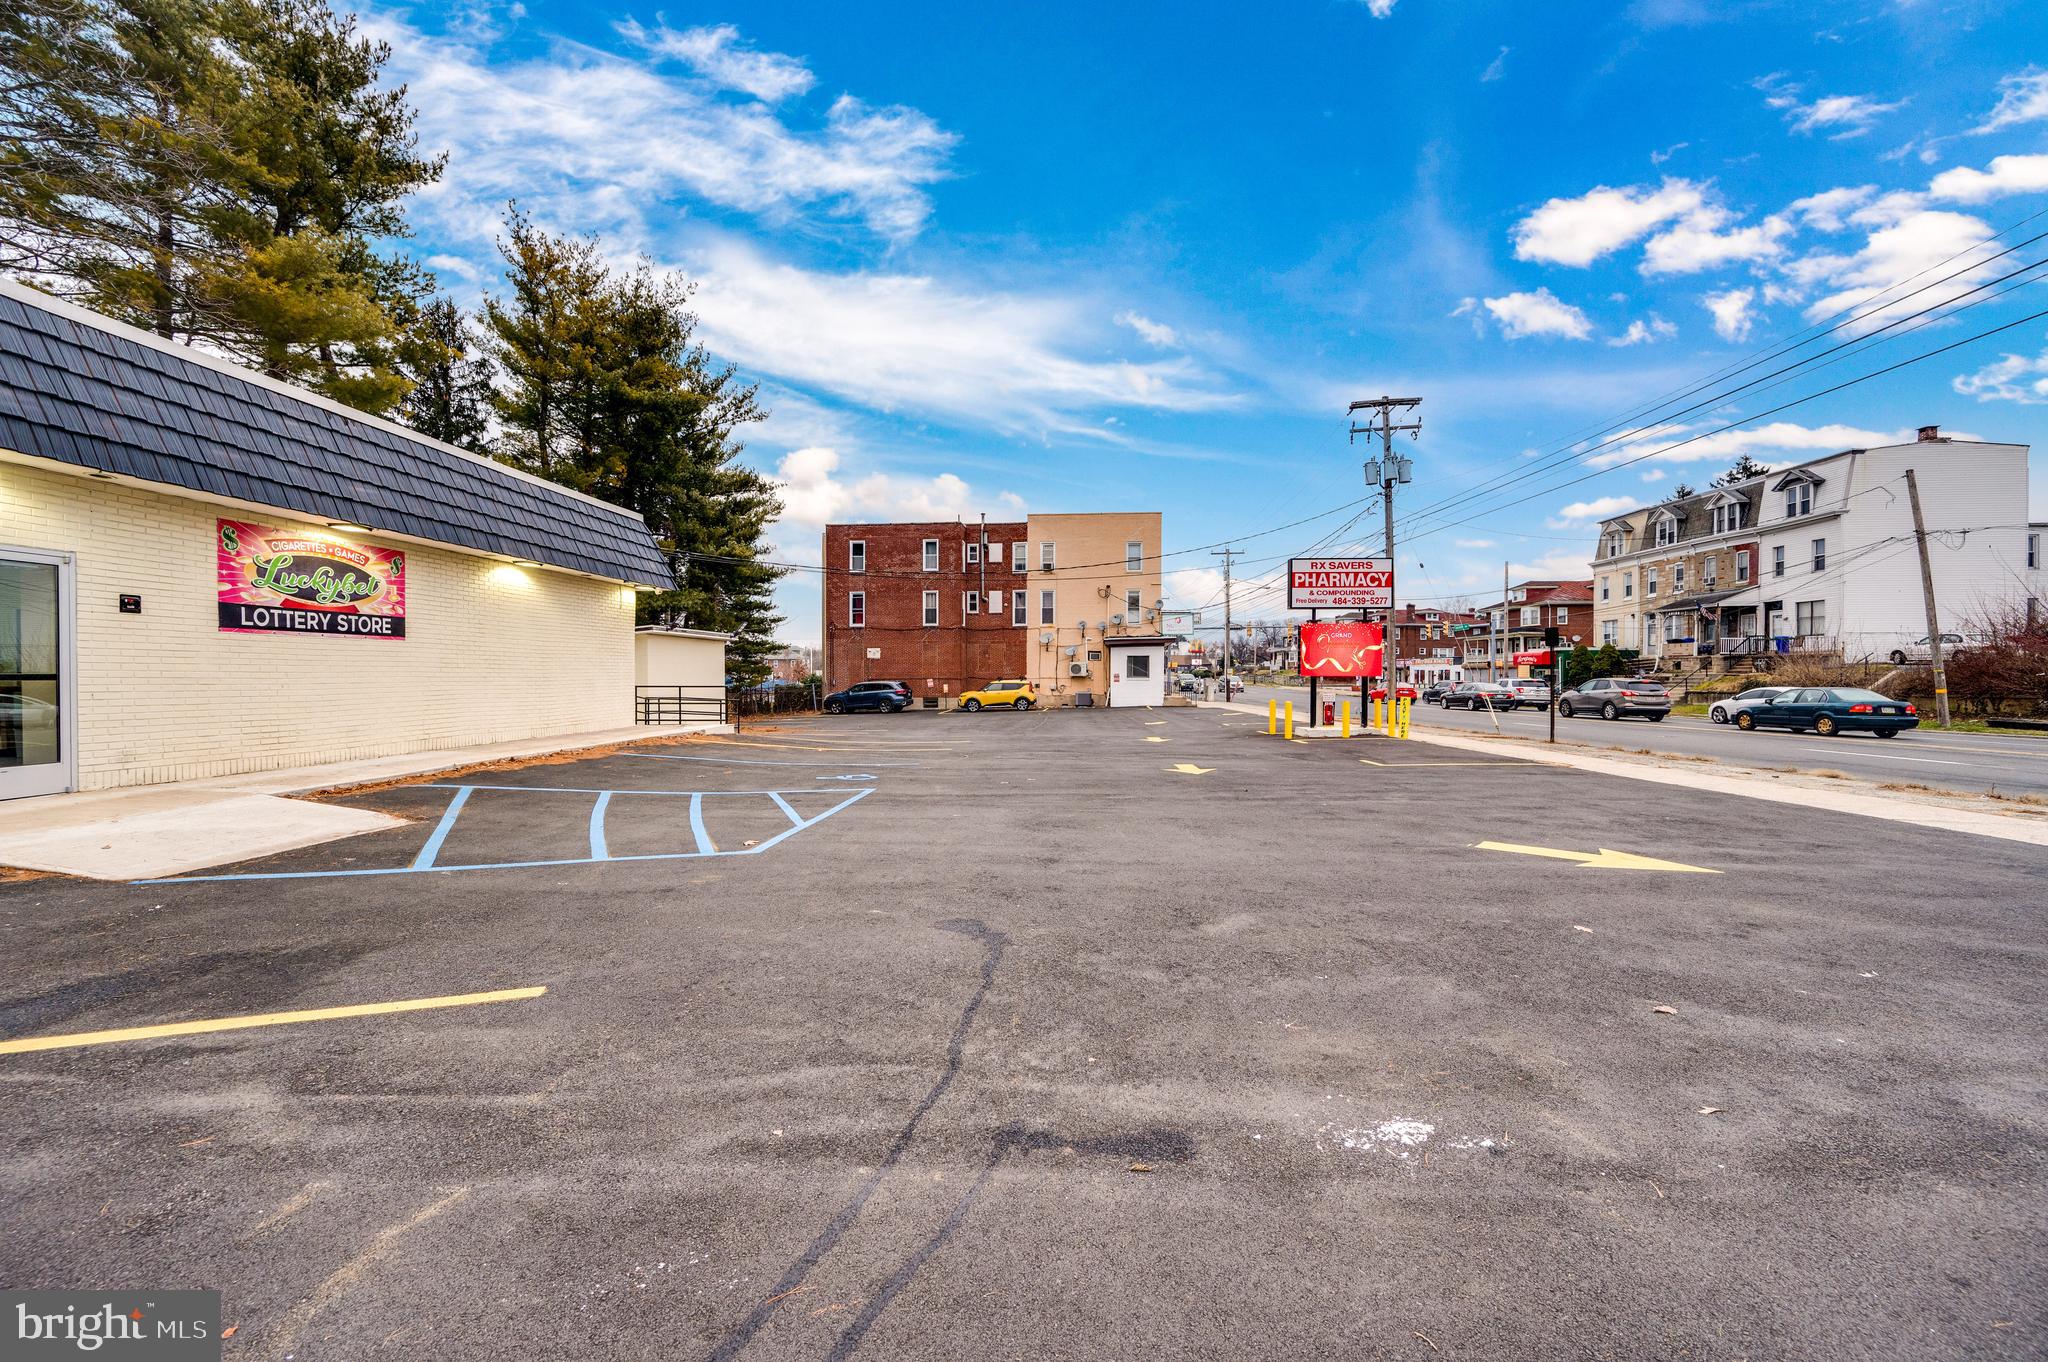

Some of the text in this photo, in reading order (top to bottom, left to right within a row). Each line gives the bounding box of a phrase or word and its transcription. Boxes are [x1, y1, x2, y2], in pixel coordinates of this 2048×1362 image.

[271, 540, 367, 565] CIGARETTES GAMES
[1310, 561, 1374, 570] RX SAVERS
[251, 553, 383, 604] Luckybet
[1294, 572, 1390, 587] PHARMACY
[1332, 597, 1388, 605] 484-339-5277
[241, 606, 392, 634] LOTTERY STORE
